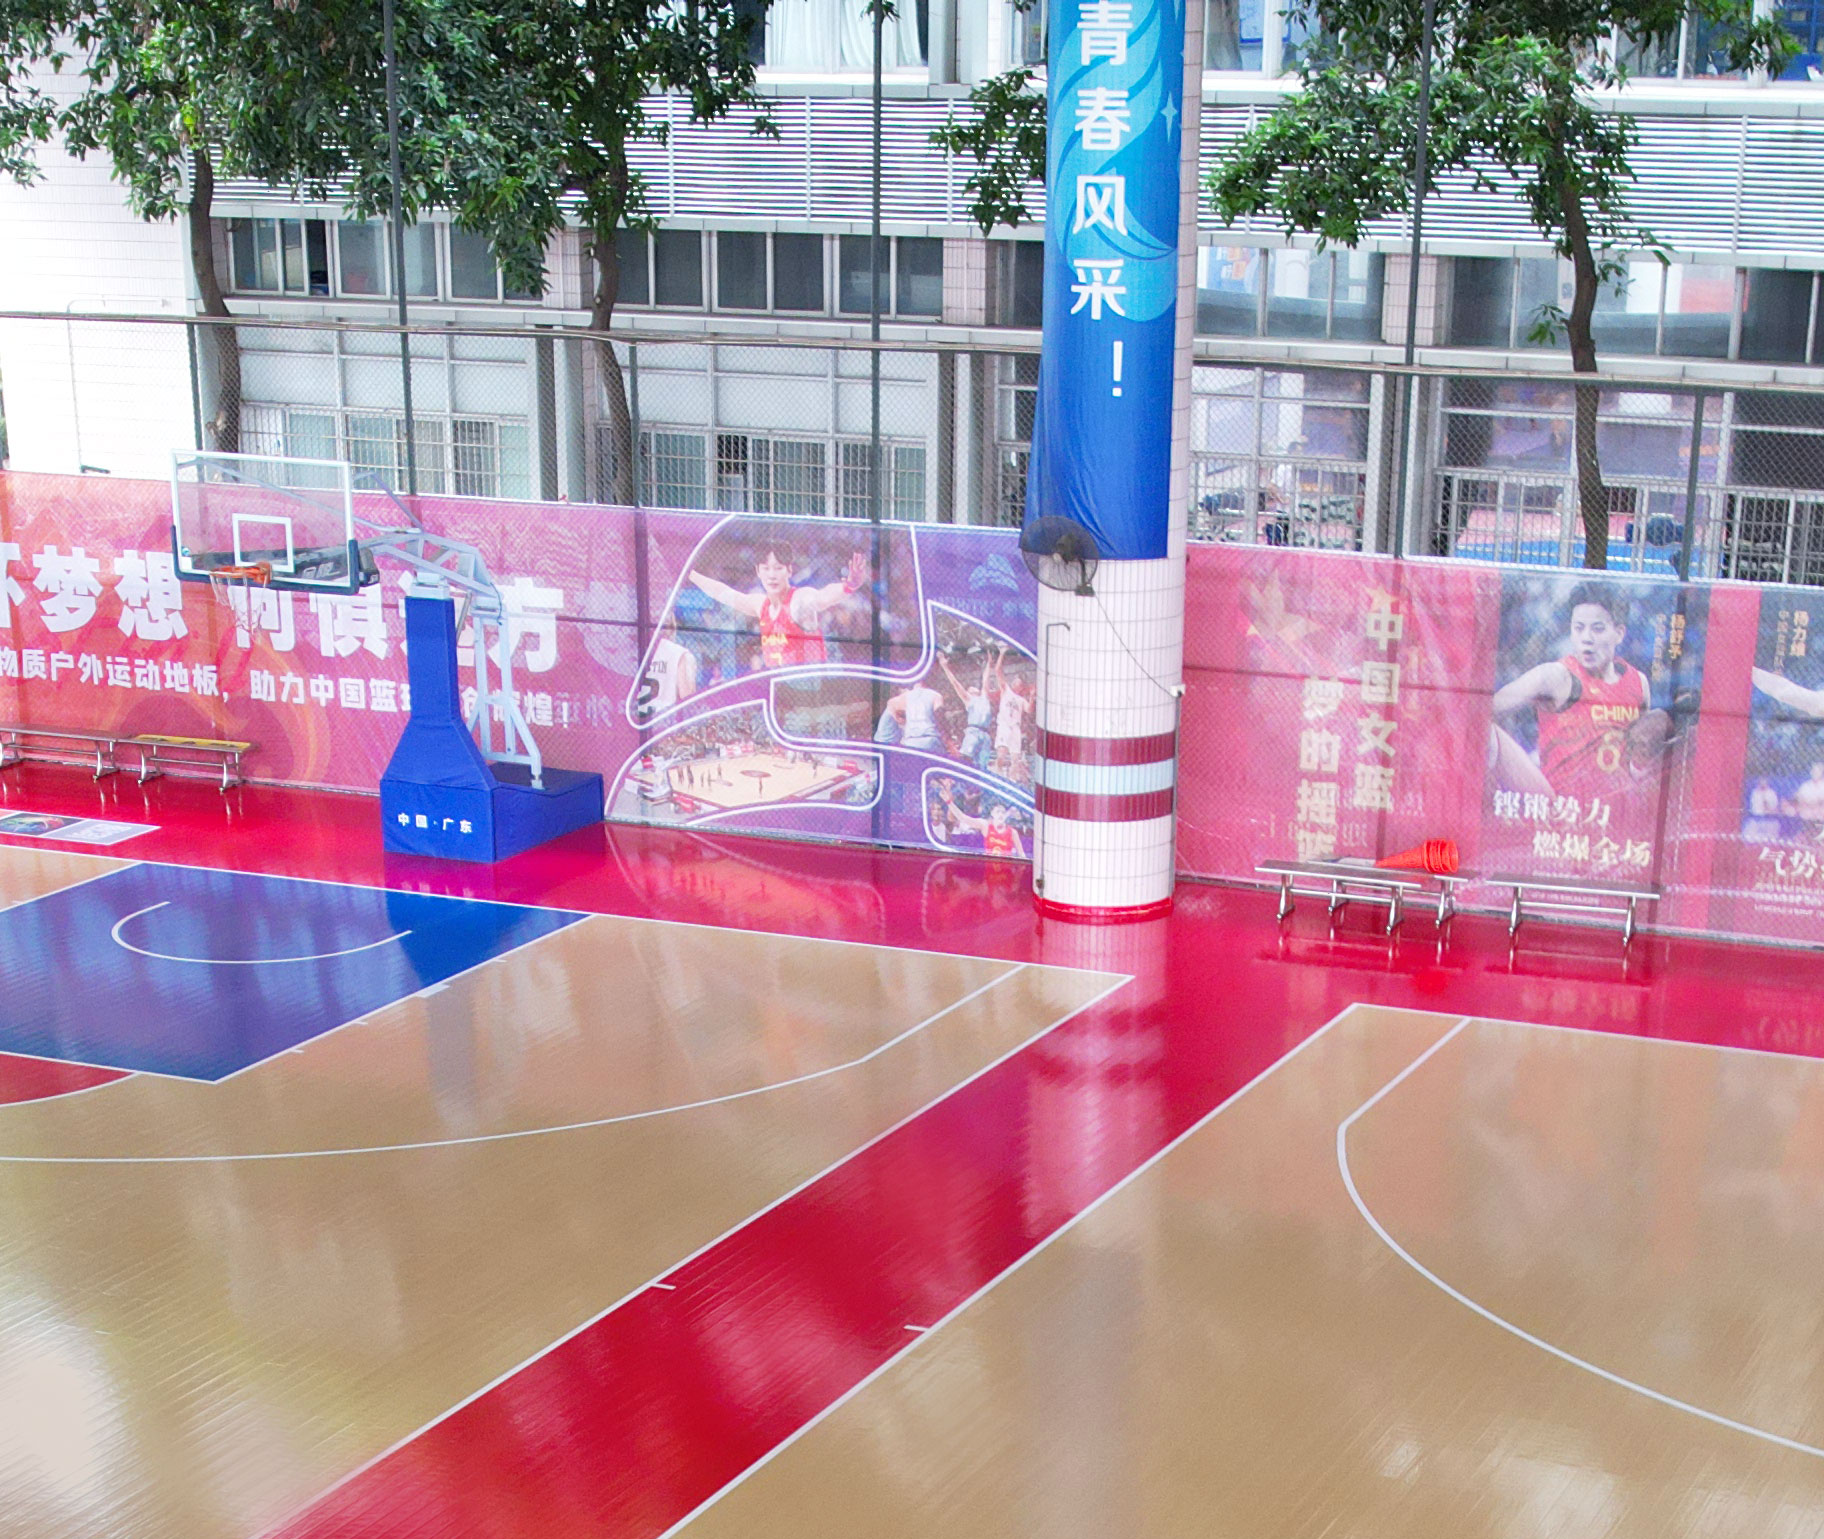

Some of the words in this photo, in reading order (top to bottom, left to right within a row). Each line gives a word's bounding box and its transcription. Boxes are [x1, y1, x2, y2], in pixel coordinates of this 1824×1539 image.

[1071, 0, 1133, 397] 青春风采！
[1297, 676, 1344, 863] 梦的摇篮
[1352, 602, 1404, 812] 中国女篮
[398, 812, 473, 834] 中国·广东
[1533, 831, 1651, 867] 燃爆全场
